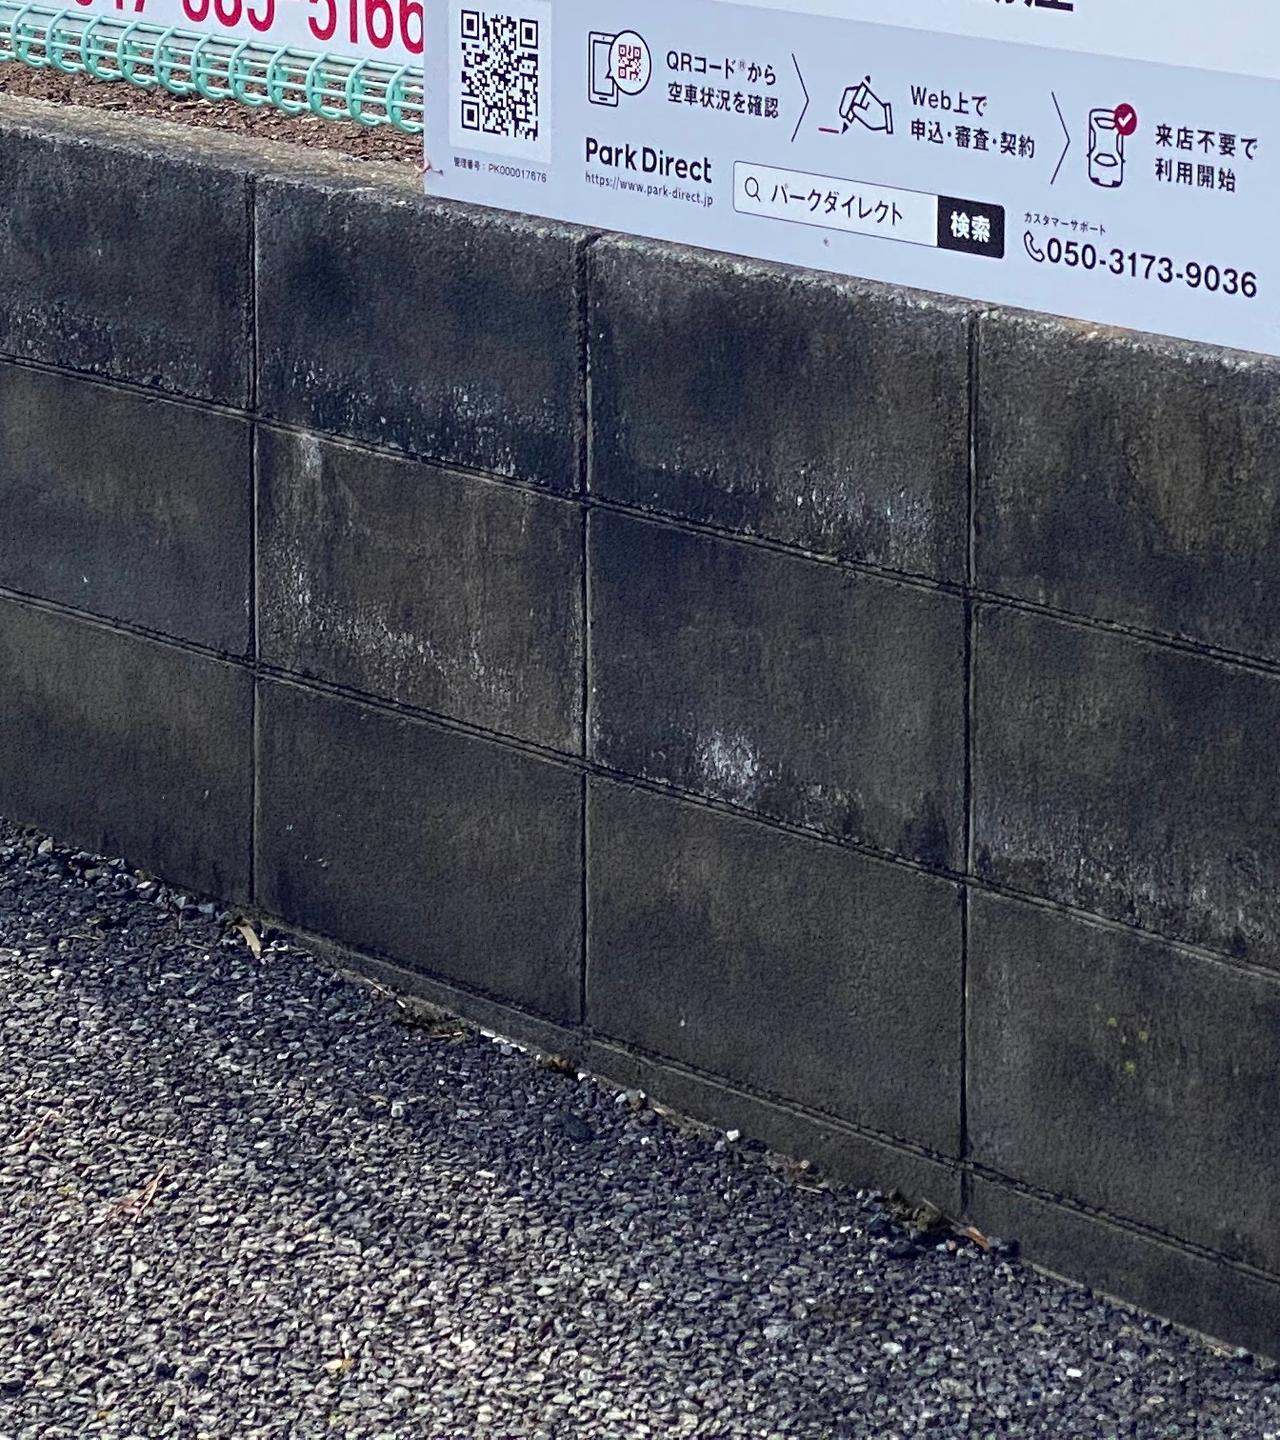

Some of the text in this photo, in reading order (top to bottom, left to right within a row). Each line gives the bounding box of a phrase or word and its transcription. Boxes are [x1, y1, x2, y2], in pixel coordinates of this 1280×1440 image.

[667, 81, 780, 120] 空車状況を確認
[910, 84, 989, 117] Web上で
[585, 137, 713, 184] Park Direct
[1155, 123, 1259, 161] 来店不要で
[585, 171, 714, 208] https://www.park-direct.jp
[1155, 158, 1237, 193] 利用開始
[771, 183, 904, 227] パークダイレクト
[1024, 211, 1107, 235] カスタマーサポート
[950, 210, 992, 244] 検索
[1046, 237, 1258, 299] 050-3173-9036
